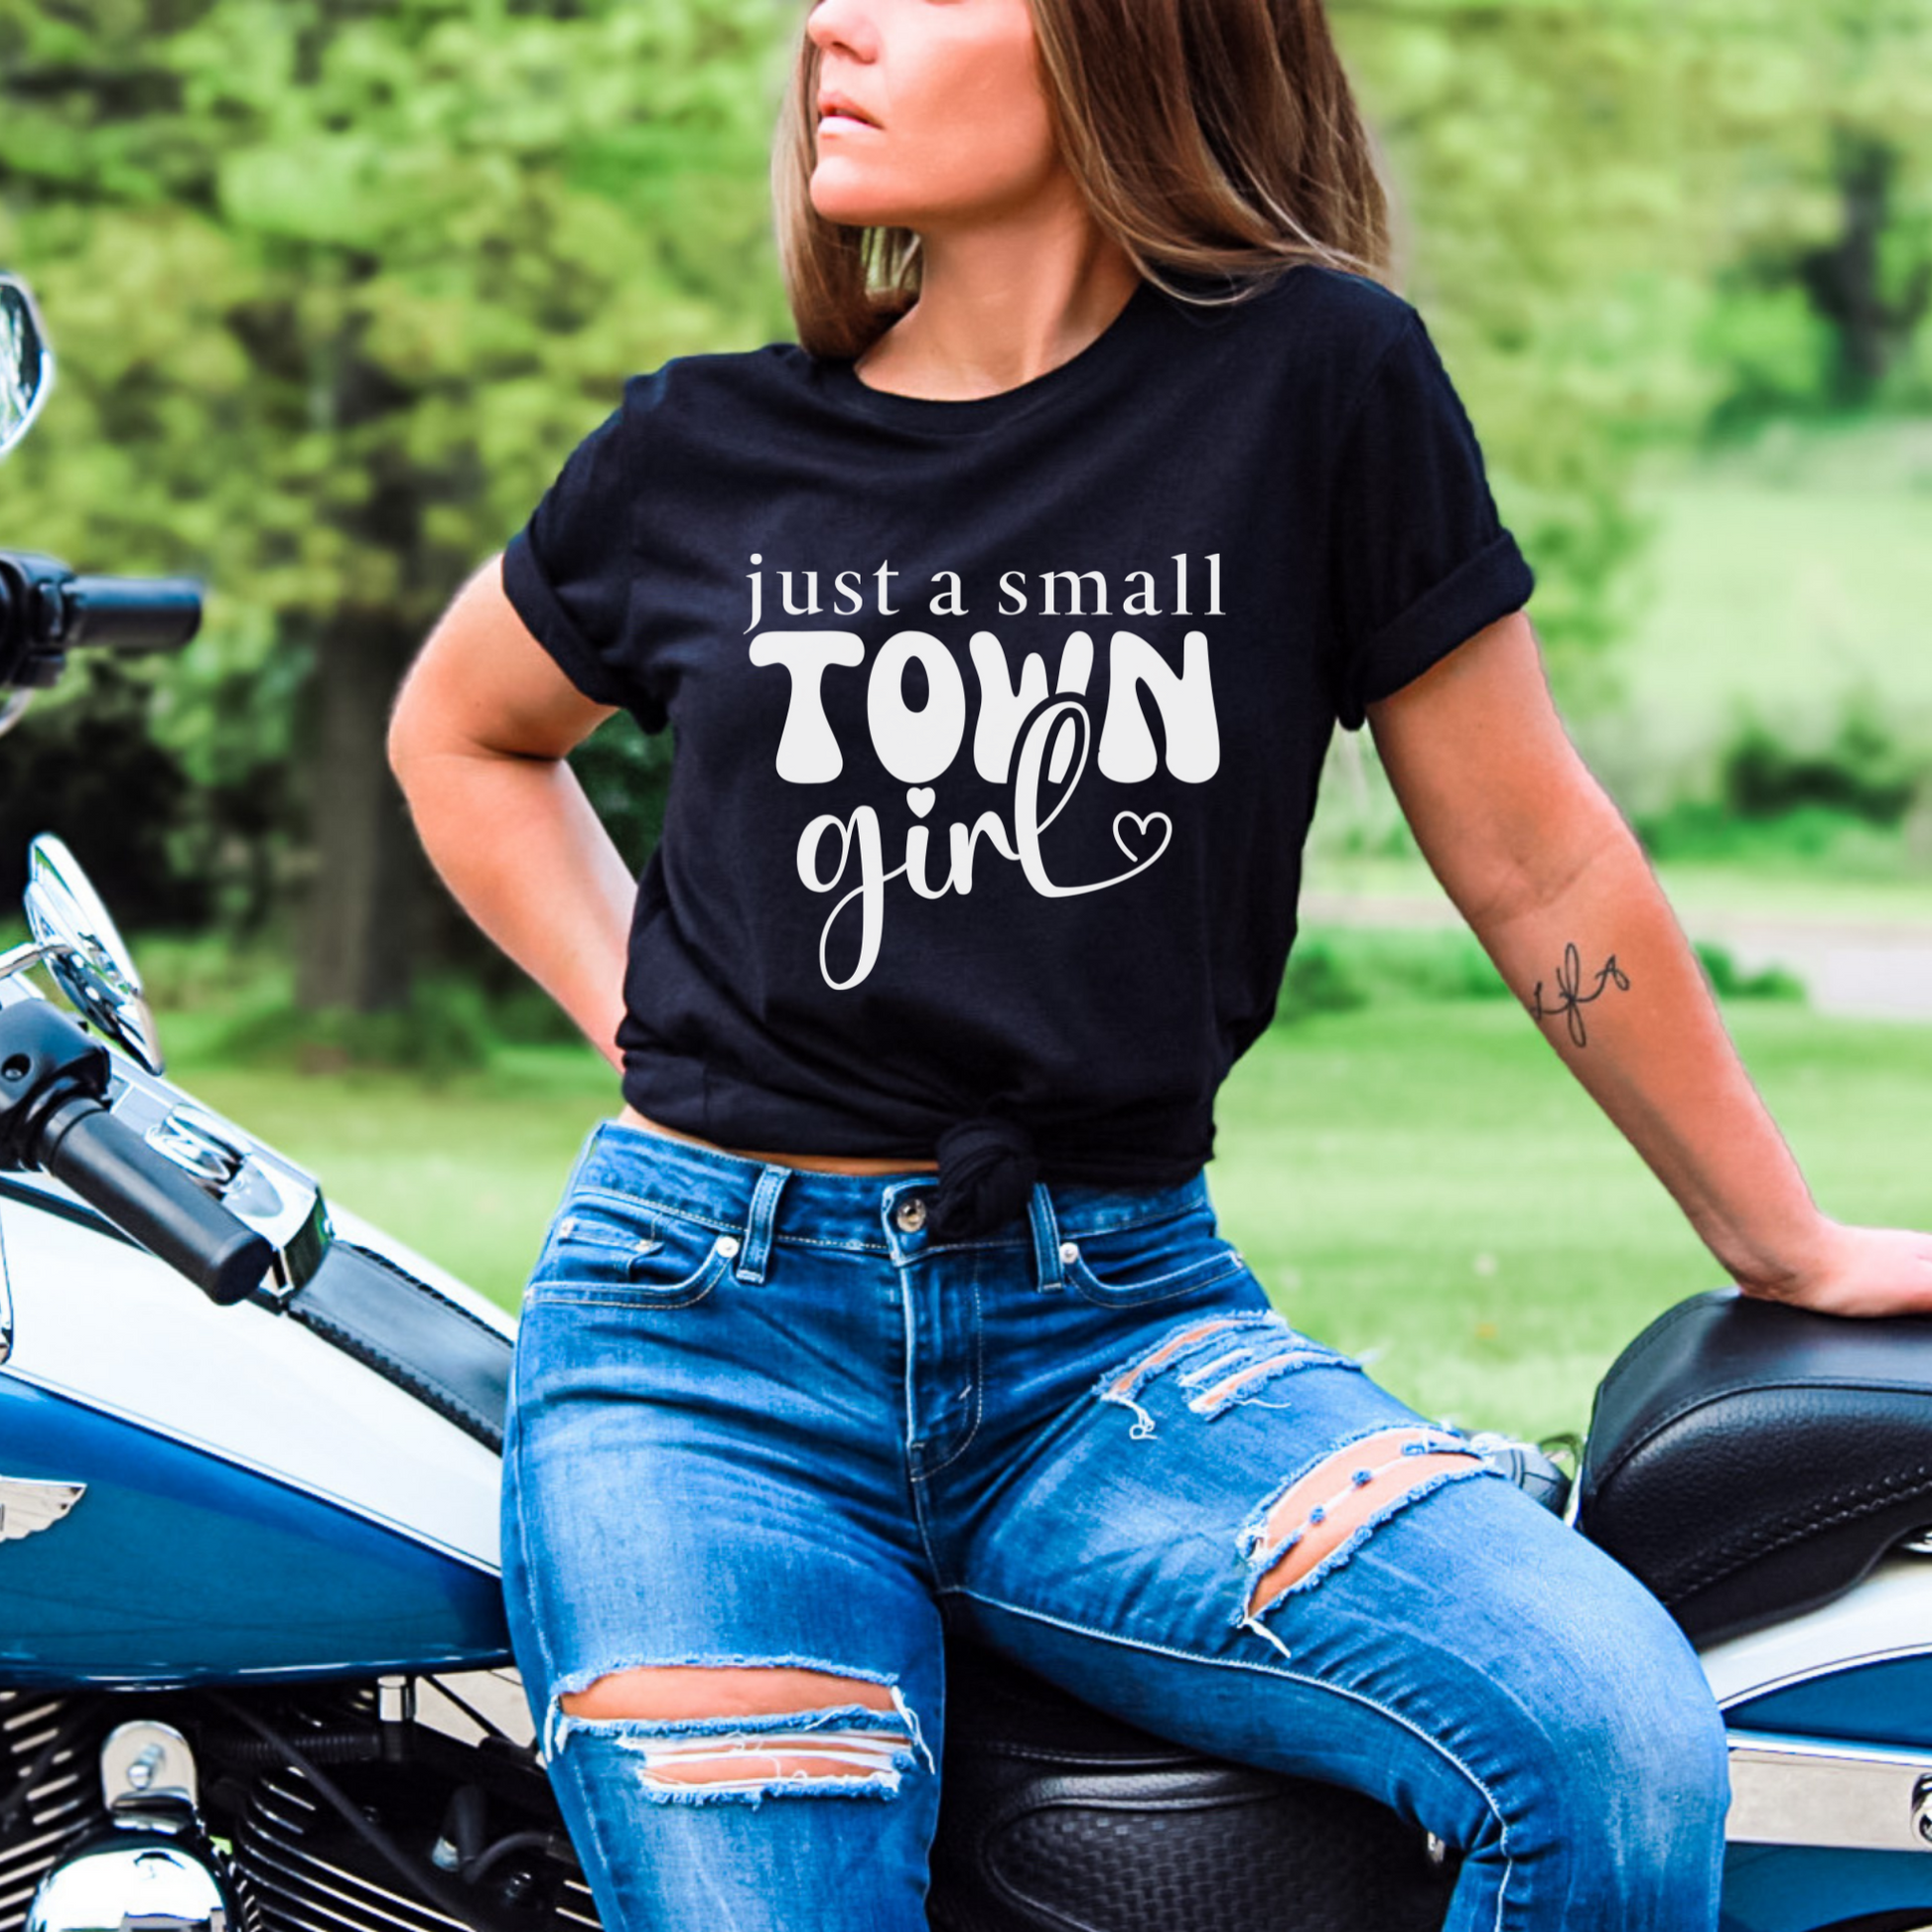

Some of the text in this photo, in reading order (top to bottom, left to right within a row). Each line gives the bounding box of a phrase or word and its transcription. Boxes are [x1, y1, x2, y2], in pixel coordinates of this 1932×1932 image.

[743, 553, 1226, 634] just a small
[749, 630, 1221, 784] TOWN
[796, 701, 1173, 991] girl
